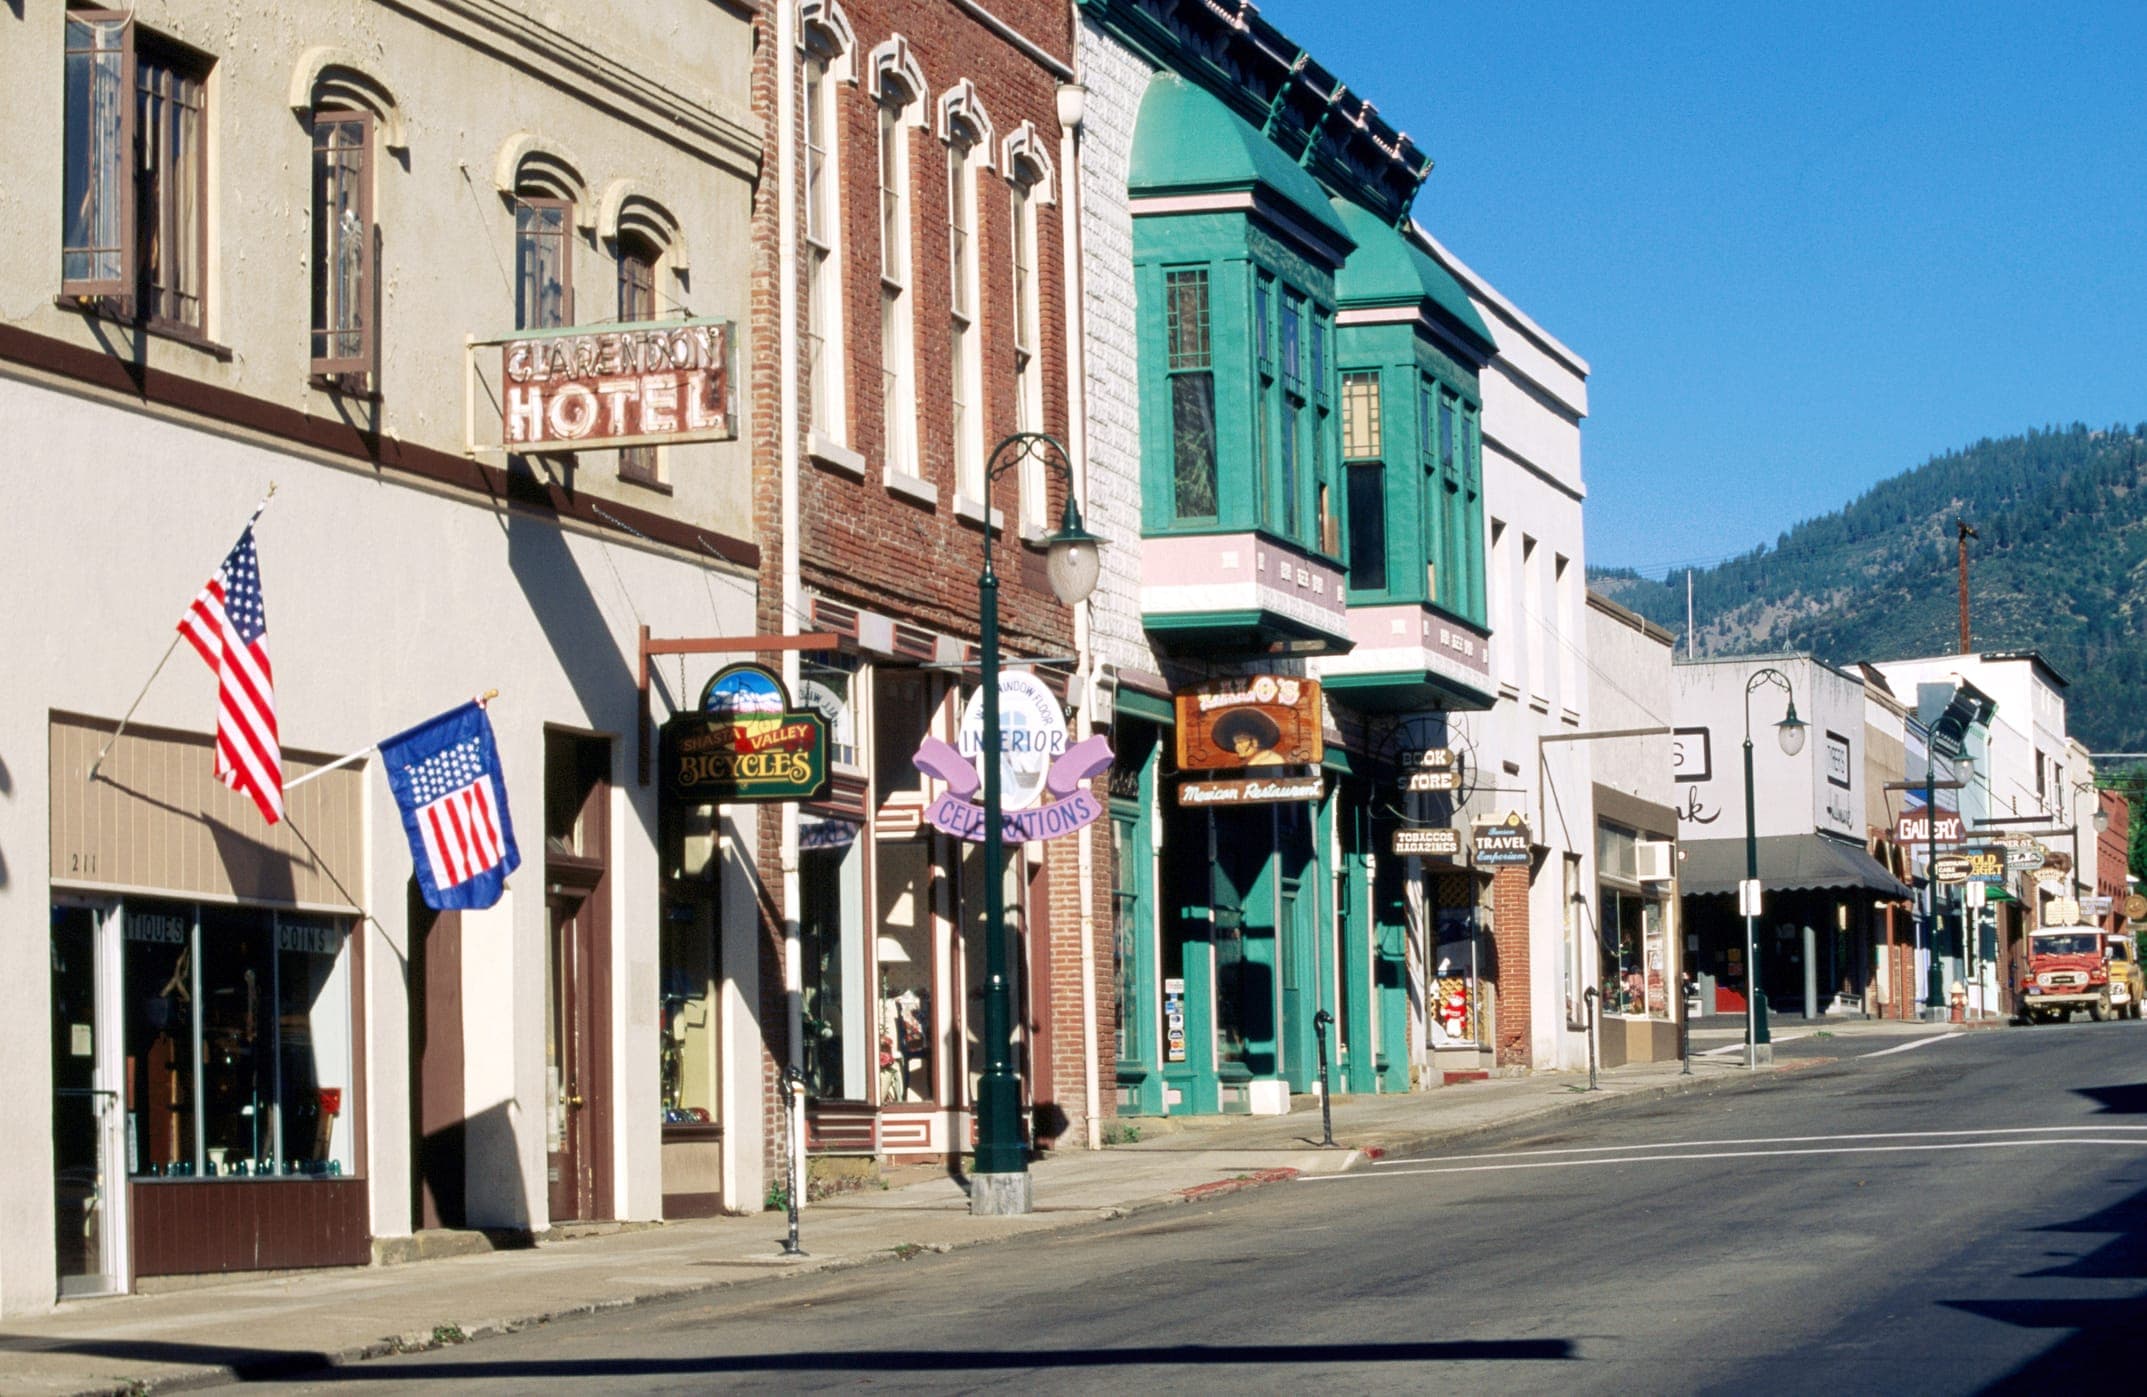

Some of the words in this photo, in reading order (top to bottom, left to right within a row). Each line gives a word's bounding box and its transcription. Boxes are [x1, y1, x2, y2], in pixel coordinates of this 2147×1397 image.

[508, 326, 724, 383] CLARENDON
[508, 370, 727, 442] HOTEL
[1032, 694, 1054, 726] FLOOR
[682, 728, 741, 751] SHASTA
[751, 724, 809, 750] VALLEY
[963, 730, 1064, 753] INERIOR
[678, 751, 812, 787] BICYCLES
[1402, 749, 1447, 767] BOOK
[1183, 785, 1238, 802] Mexican
[1243, 778, 1324, 800] Restaurant
[1397, 772, 1453, 790] STORE
[938, 797, 1091, 838] CELERATIONS
[1396, 842, 1457, 852] MAGAZINES
[1397, 832, 1454, 842] TOBACCOS
[1475, 837, 1527, 849] TRAVEL
[71, 853, 97, 873] 211
[1476, 851, 1527, 863] Emporium
[126, 914, 184, 942] TIQUES
[280, 926, 326, 952] COINS
